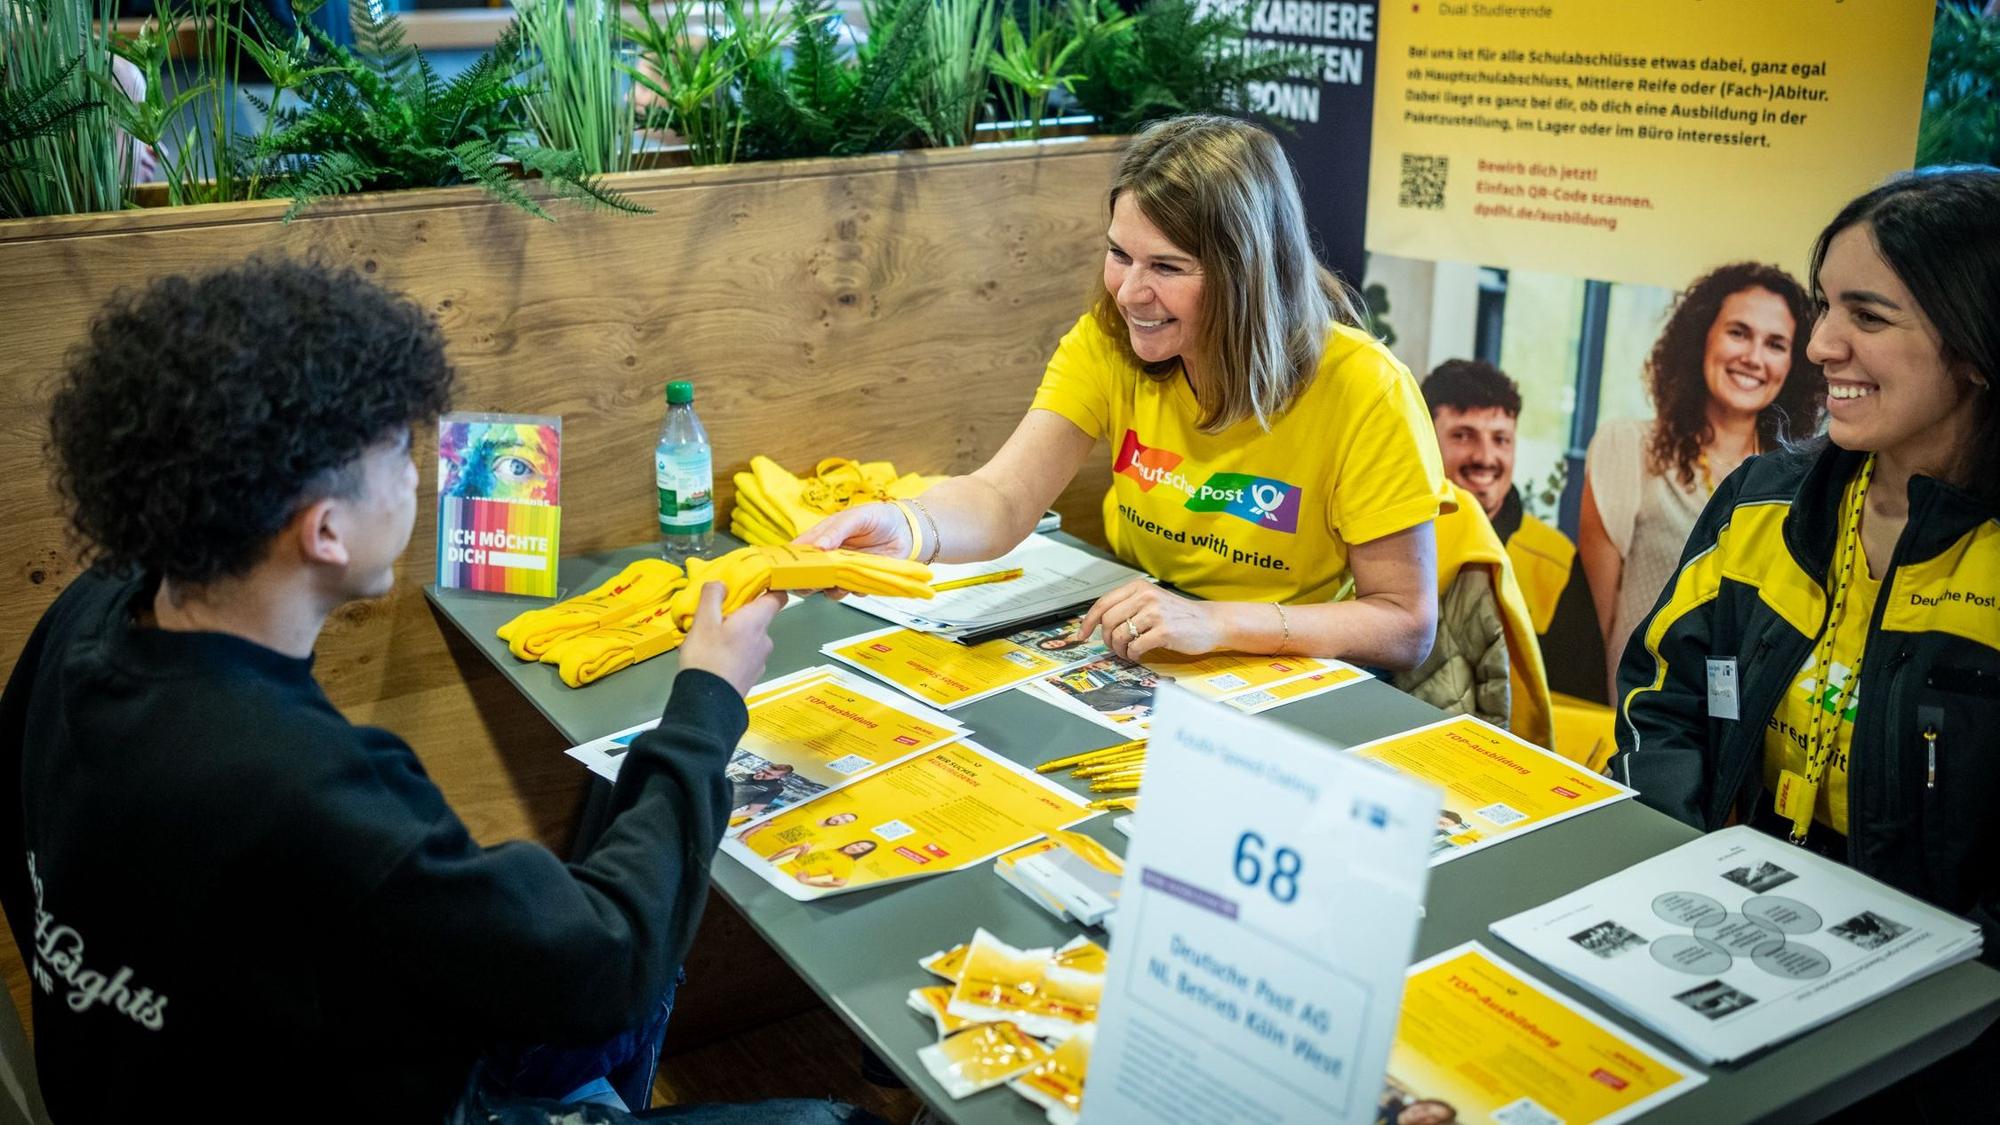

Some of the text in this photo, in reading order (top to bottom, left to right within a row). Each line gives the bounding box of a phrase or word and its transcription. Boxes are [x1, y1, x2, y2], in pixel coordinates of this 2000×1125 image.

[1251, 0, 1375, 41] KARRIERE
[1438, 3, 1552, 18] Dual Studierende
[1408, 46, 1826, 79] Bei uns ist für alle Schulabschlüsse etwas dabei, ganz egal
[1407, 69, 1829, 102] ob Hauptschulabschluss, Mittlere Reife oder (Fach-)Abitur.
[1405, 89, 1807, 125] Dabei liegt es ganz bei dir, ob dich eine Ausbildung in der
[1404, 111, 1770, 148] Paketzustellung, im Lager oder im Büro interessiert.
[1477, 159, 1597, 182] Bewirb dich jetzt!
[1476, 181, 1655, 210] Einfach QR-Code scannen.
[1474, 203, 1617, 231] dpdhl.de/ausbildung
[1200, 485, 1244, 503] Post
[447, 547, 486, 565] DICH
[448, 529, 548, 552] ICH MÖCHTE
[1191, 534, 1229, 557] with
[1232, 549, 1290, 571] pride.
[1911, 589, 1996, 607] Deuhe Post
[806, 695, 879, 729] TOP-Ausbildung
[1445, 731, 1531, 775] TOP-Ausbildung
[1232, 830, 1305, 905] 68
[1170, 934, 1331, 1036] Deutsche Post AG
[1175, 973, 1241, 1024] Betrieb
[1244, 1007, 1287, 1048] Köln
[1292, 1029, 1343, 1081] West
[1449, 975, 1561, 1048] TOP-Ausbildung
